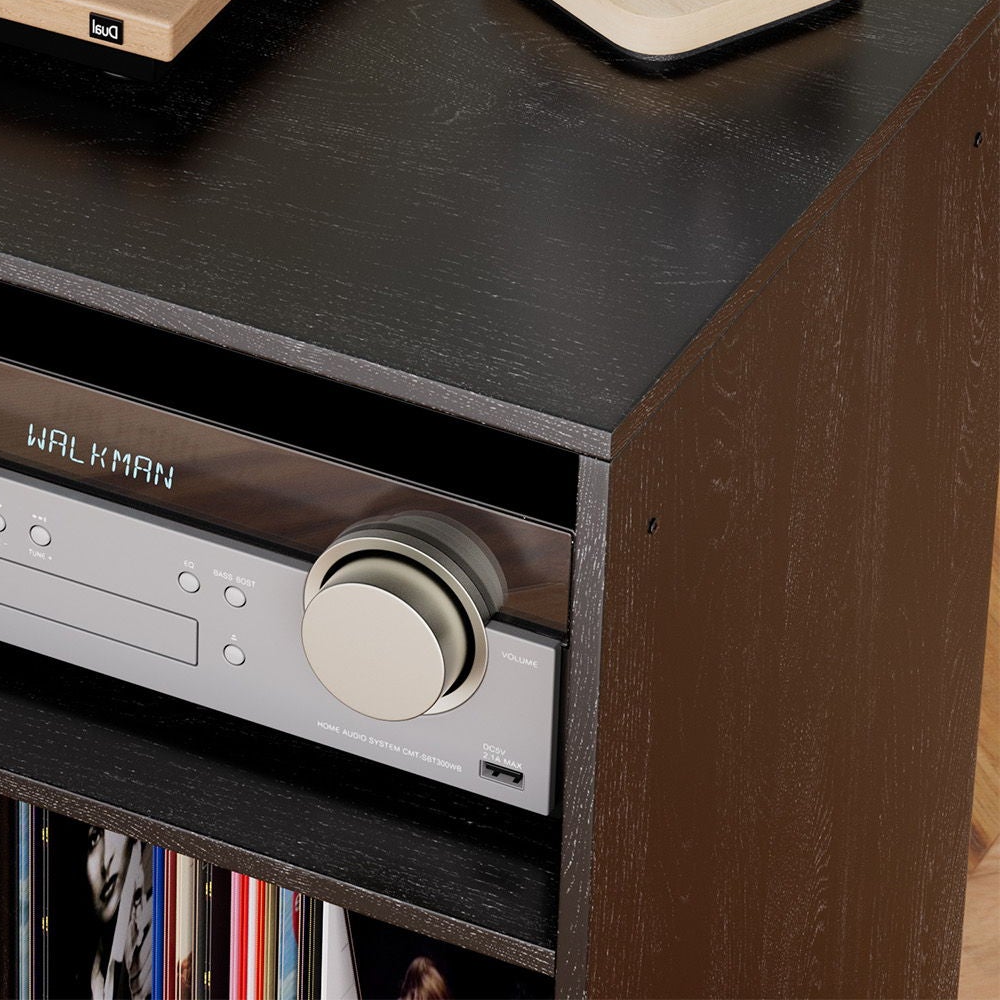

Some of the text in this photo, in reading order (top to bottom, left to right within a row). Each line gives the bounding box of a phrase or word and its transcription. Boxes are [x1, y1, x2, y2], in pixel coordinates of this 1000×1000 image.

[27, 423, 174, 490] WALKMAN
[501, 650, 539, 669] VOLUME
[317, 720, 341, 734] HOME
[342, 728, 367, 742] AUDIO
[368, 736, 401, 753] SYSTEM
[503, 758, 522, 770] MAX
